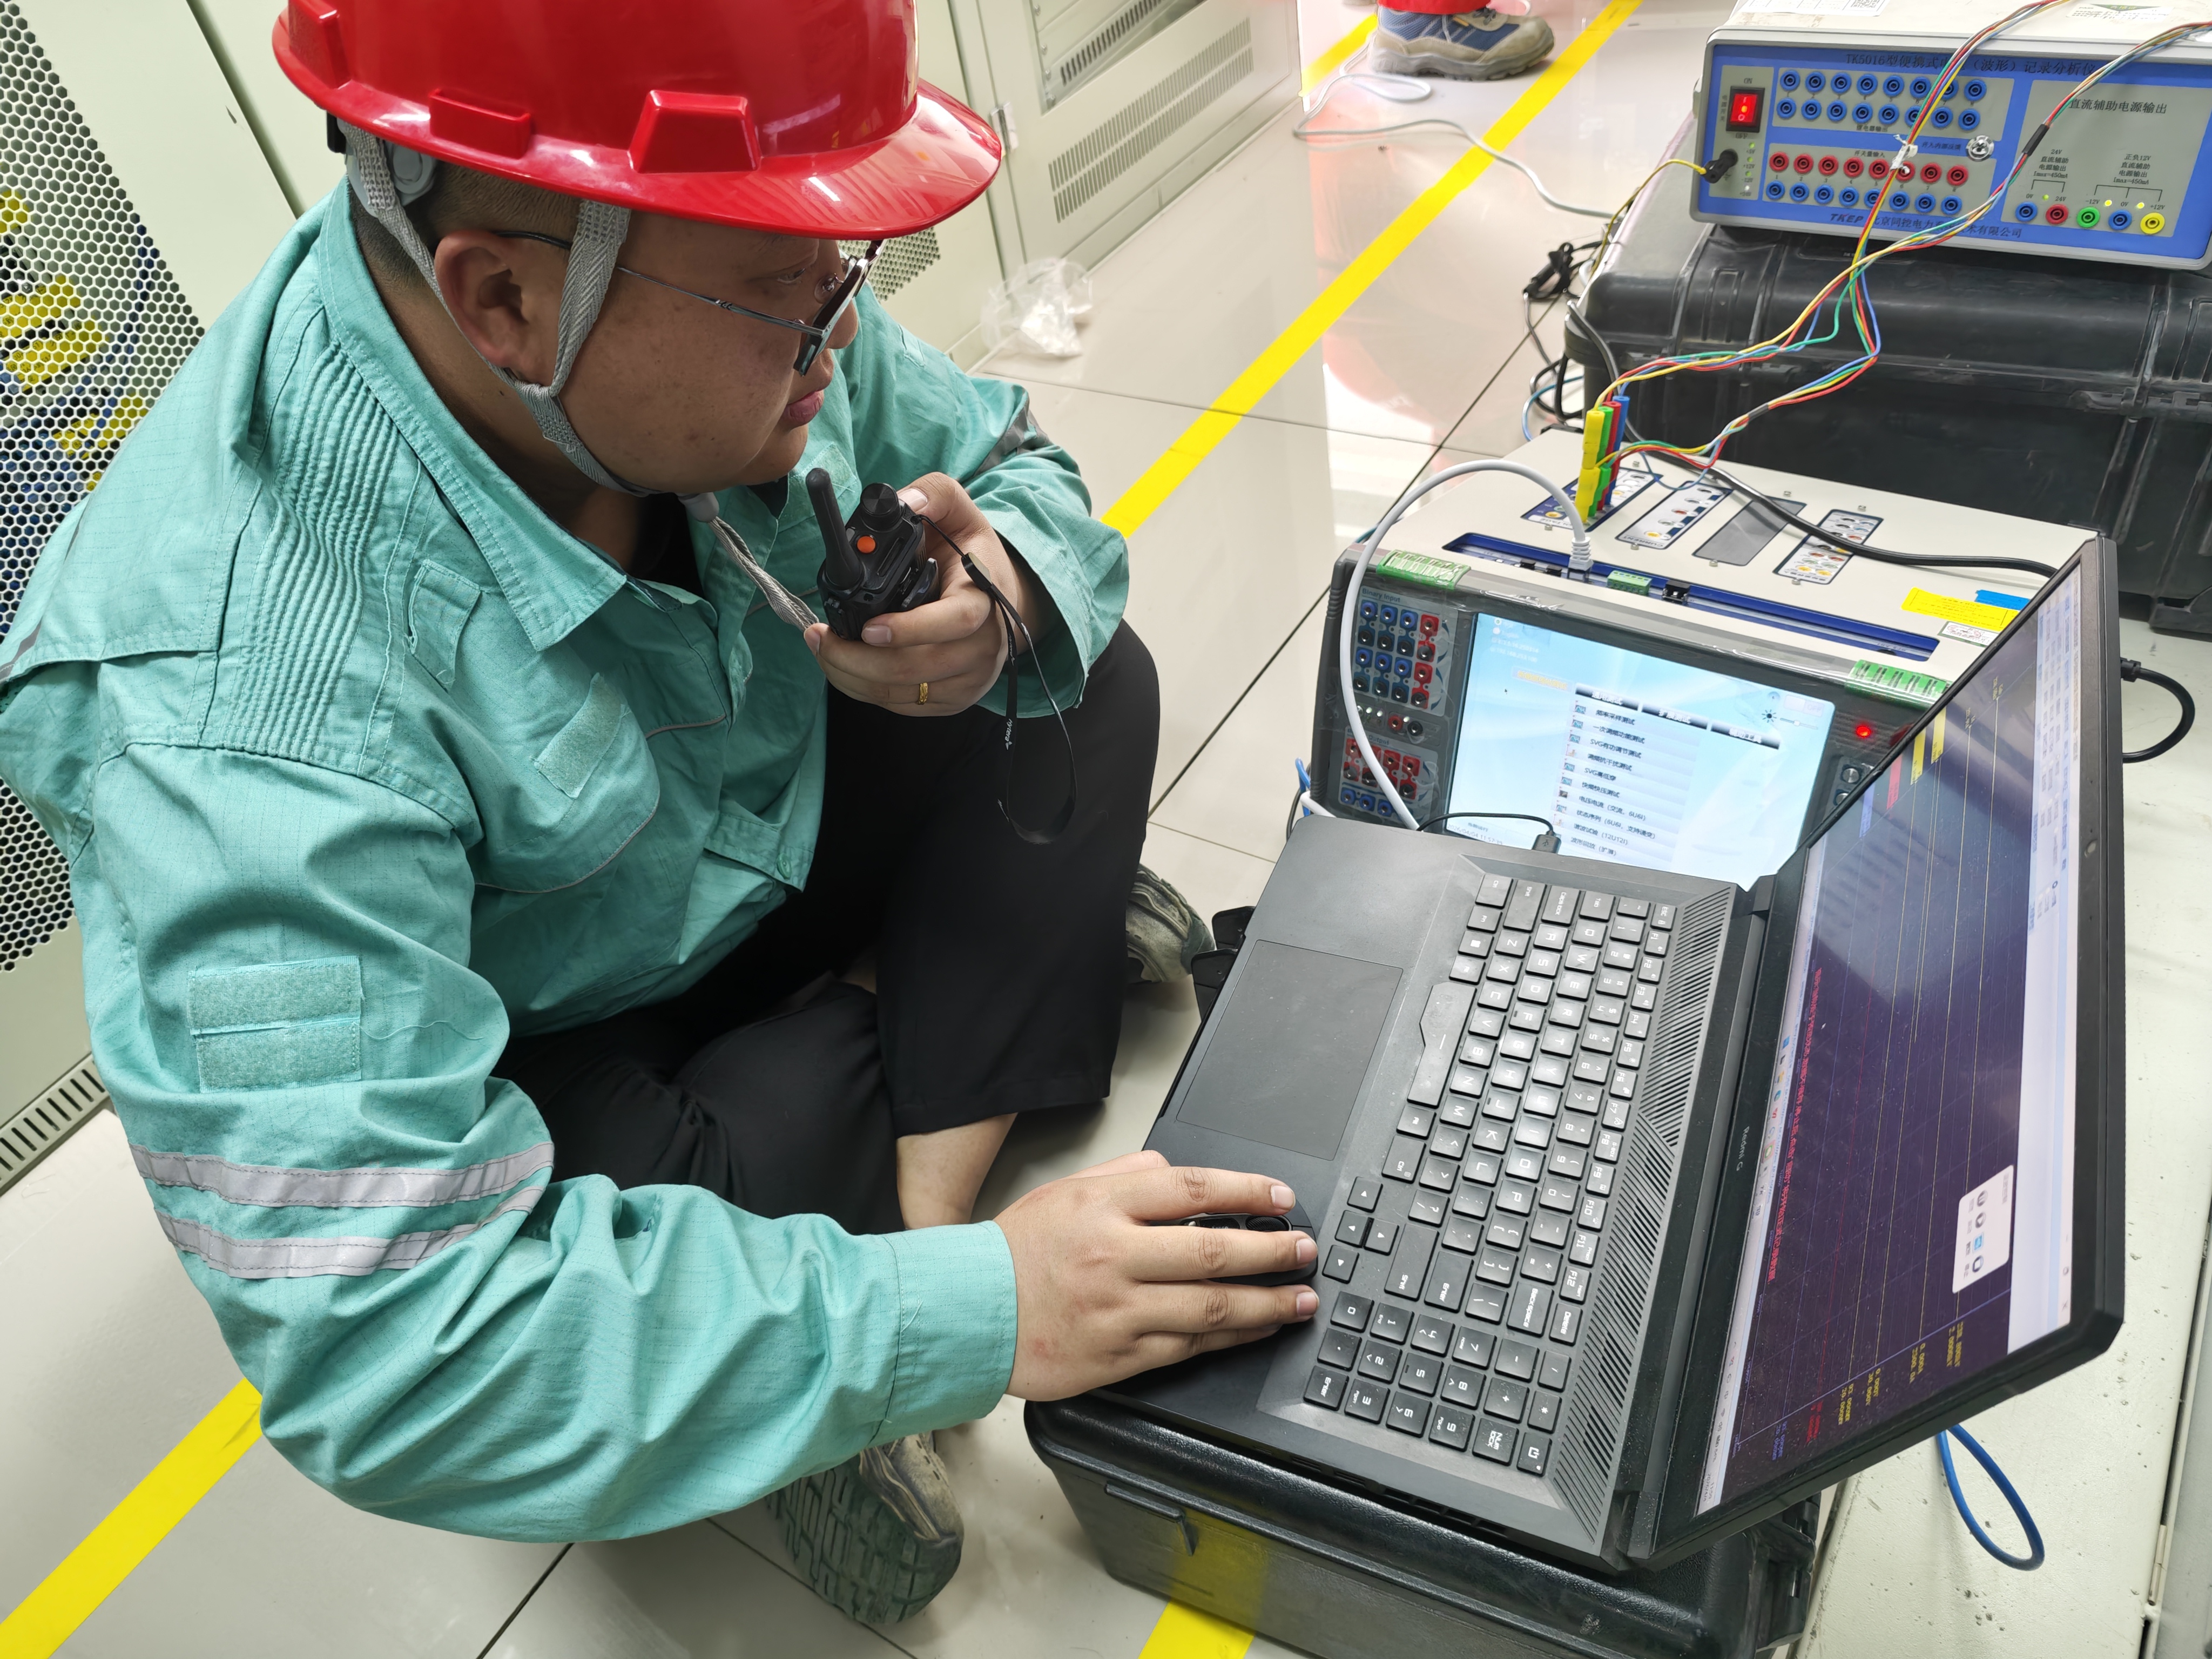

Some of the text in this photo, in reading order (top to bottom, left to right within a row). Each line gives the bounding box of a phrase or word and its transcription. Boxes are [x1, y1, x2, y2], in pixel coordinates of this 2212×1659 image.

[2069, 99, 2167, 114] 直流辅助电源输出
[2041, 156, 2069, 164] 直流辅助
[2119, 170, 2148, 178] 电源输出
[1830, 213, 1863, 223] TKEP
[1362, 588, 1400, 603] Binary Input
[1591, 691, 1624, 705] 通用测试
[1593, 725, 1645, 744] 一次调频功能测试
[1590, 739, 1642, 759] SVG有功调节测试
[1584, 928, 1595, 936] Q
[1650, 932, 1658, 940] F1
[1507, 939, 1518, 947] Z
[1576, 954, 1588, 965] W
[1643, 959, 1652, 969] F2
[1499, 965, 1509, 973] X
[1530, 984, 1541, 993] D
[1569, 981, 1581, 989] E
[1636, 986, 1646, 996] F3
[1522, 1013, 1533, 1021] F
[1562, 1008, 1573, 1016] R
[1630, 1014, 1639, 1024] F4
[1513, 1040, 1525, 1049] G
[1554, 1037, 1565, 1046] T
[1472, 1047, 1483, 1056] B
[1623, 1042, 1631, 1053] F5
[1505, 1069, 1516, 1079] H
[1546, 1067, 1557, 1076] Y
[1463, 1076, 1474, 1086] N
[1495, 1100, 1505, 1110] J
[1536, 1096, 1548, 1105] U
[1452, 1105, 1466, 1117] M
[1610, 1103, 1618, 1114] F7
[1486, 1130, 1498, 1140] K
[1736, 1125, 1750, 1172] Redmi G
[1398, 1274, 1409, 1290] Shift
[1566, 1270, 1577, 1287] F12
[1439, 1283, 1450, 1302] Enter
[1347, 1306, 1356, 1315] 0
[1560, 1311, 1572, 1335] Delete
[1428, 1330, 1437, 1339] 4
[1469, 1343, 1479, 1352] 7
[1374, 1355, 1385, 1366] 2
[1415, 1368, 1426, 1378] 5
[1319, 1377, 1332, 1397] Enter
[1458, 1381, 1468, 1391] 8
[1361, 1395, 1372, 1405] 3
[1404, 1408, 1414, 1418] 6
[1447, 1422, 1457, 1432] 9
